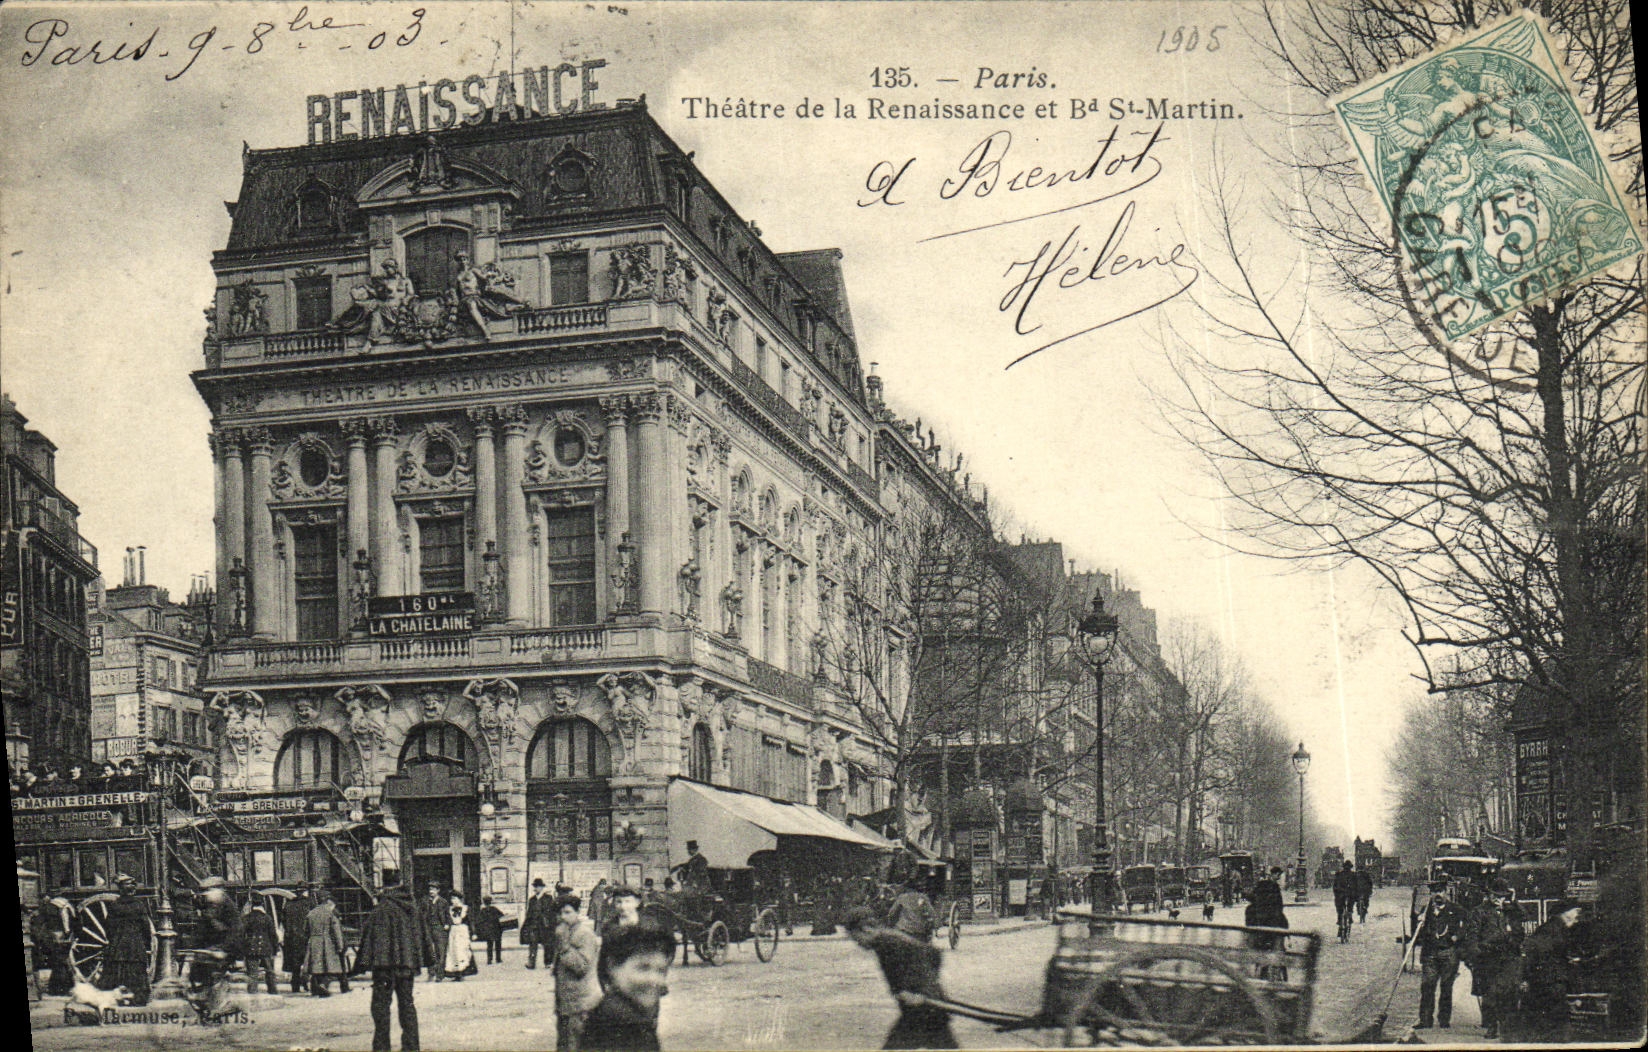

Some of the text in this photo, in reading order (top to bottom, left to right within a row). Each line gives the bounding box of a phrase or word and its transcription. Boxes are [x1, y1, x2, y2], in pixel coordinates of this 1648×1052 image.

[1156, 25, 1228, 53] 1905
[307, 59, 607, 145] RENAISSANCE
[418, 381, 438, 396] LA
[450, 369, 569, 393] RENAISSANCE
[370, 614, 473, 635] LA CHATELAINE
[25, 797, 66, 808] MARTIN
[78, 792, 140, 805] GRENELLE
[252, 799, 299, 810] GRENELLE
